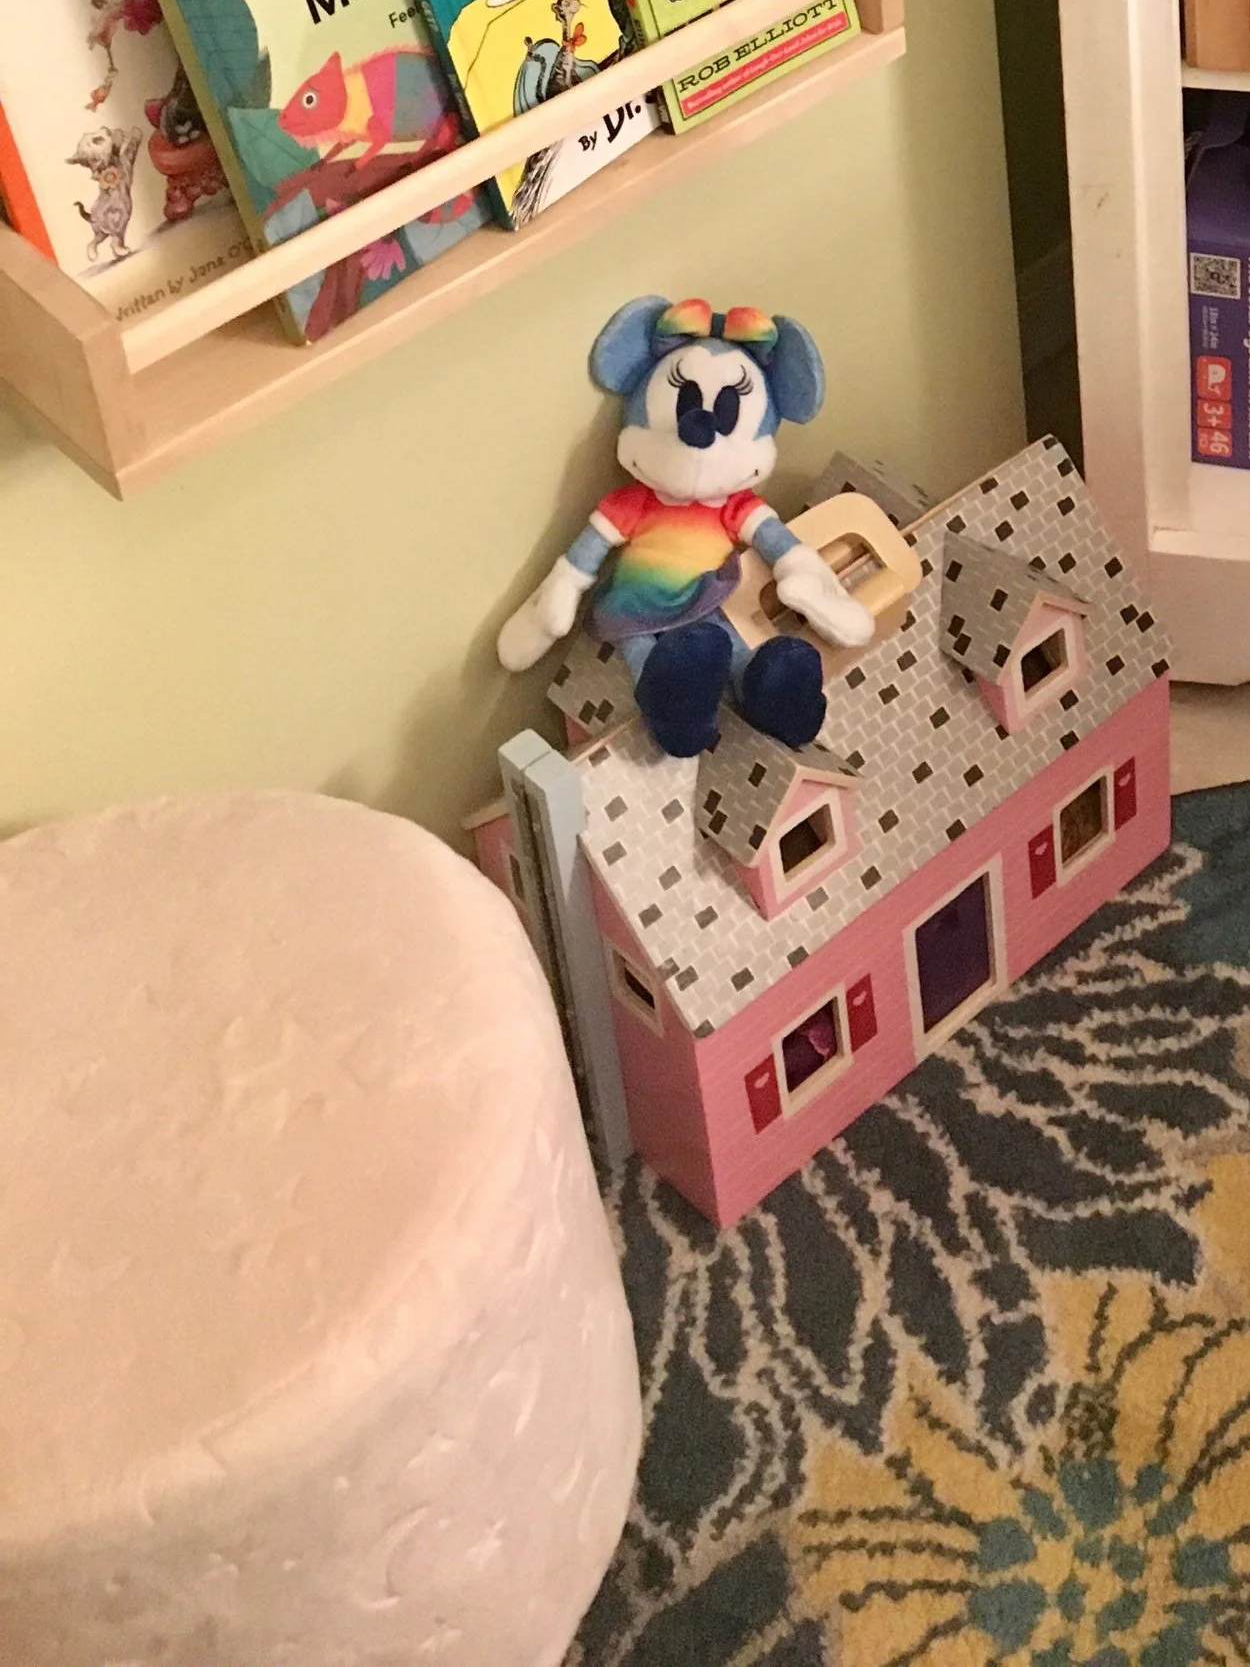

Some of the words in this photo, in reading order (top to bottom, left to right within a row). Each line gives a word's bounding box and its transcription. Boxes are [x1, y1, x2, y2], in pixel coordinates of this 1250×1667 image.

[388, 2, 423, 29] Feel
[678, 54, 732, 94] ROB
[577, 130, 598, 152] By
[167, 276, 185, 295] by
[188, 255, 225, 284] Jane
[1203, 404, 1225, 426] 3+
[1209, 430, 1230, 455] 46
